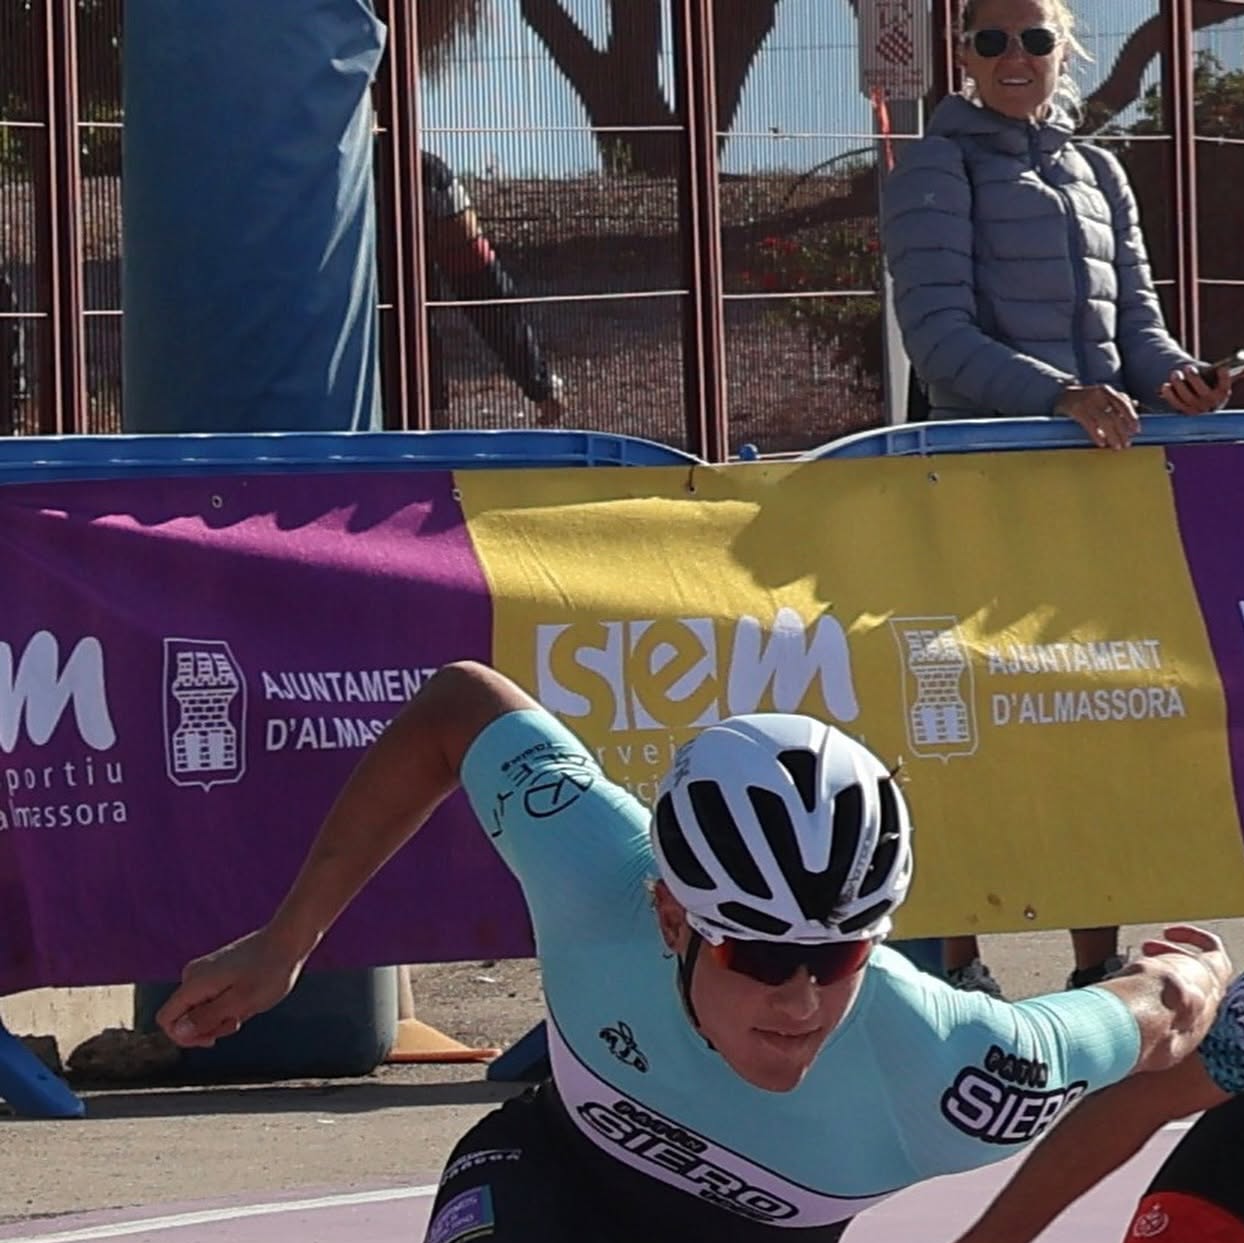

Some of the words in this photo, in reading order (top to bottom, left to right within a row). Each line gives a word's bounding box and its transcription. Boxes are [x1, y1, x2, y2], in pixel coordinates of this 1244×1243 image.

[988, 640, 1161, 674] AJUNTAMENT
[993, 688, 1186, 726] D'ALMASSORA
[579, 1102, 798, 1219] SIERO
